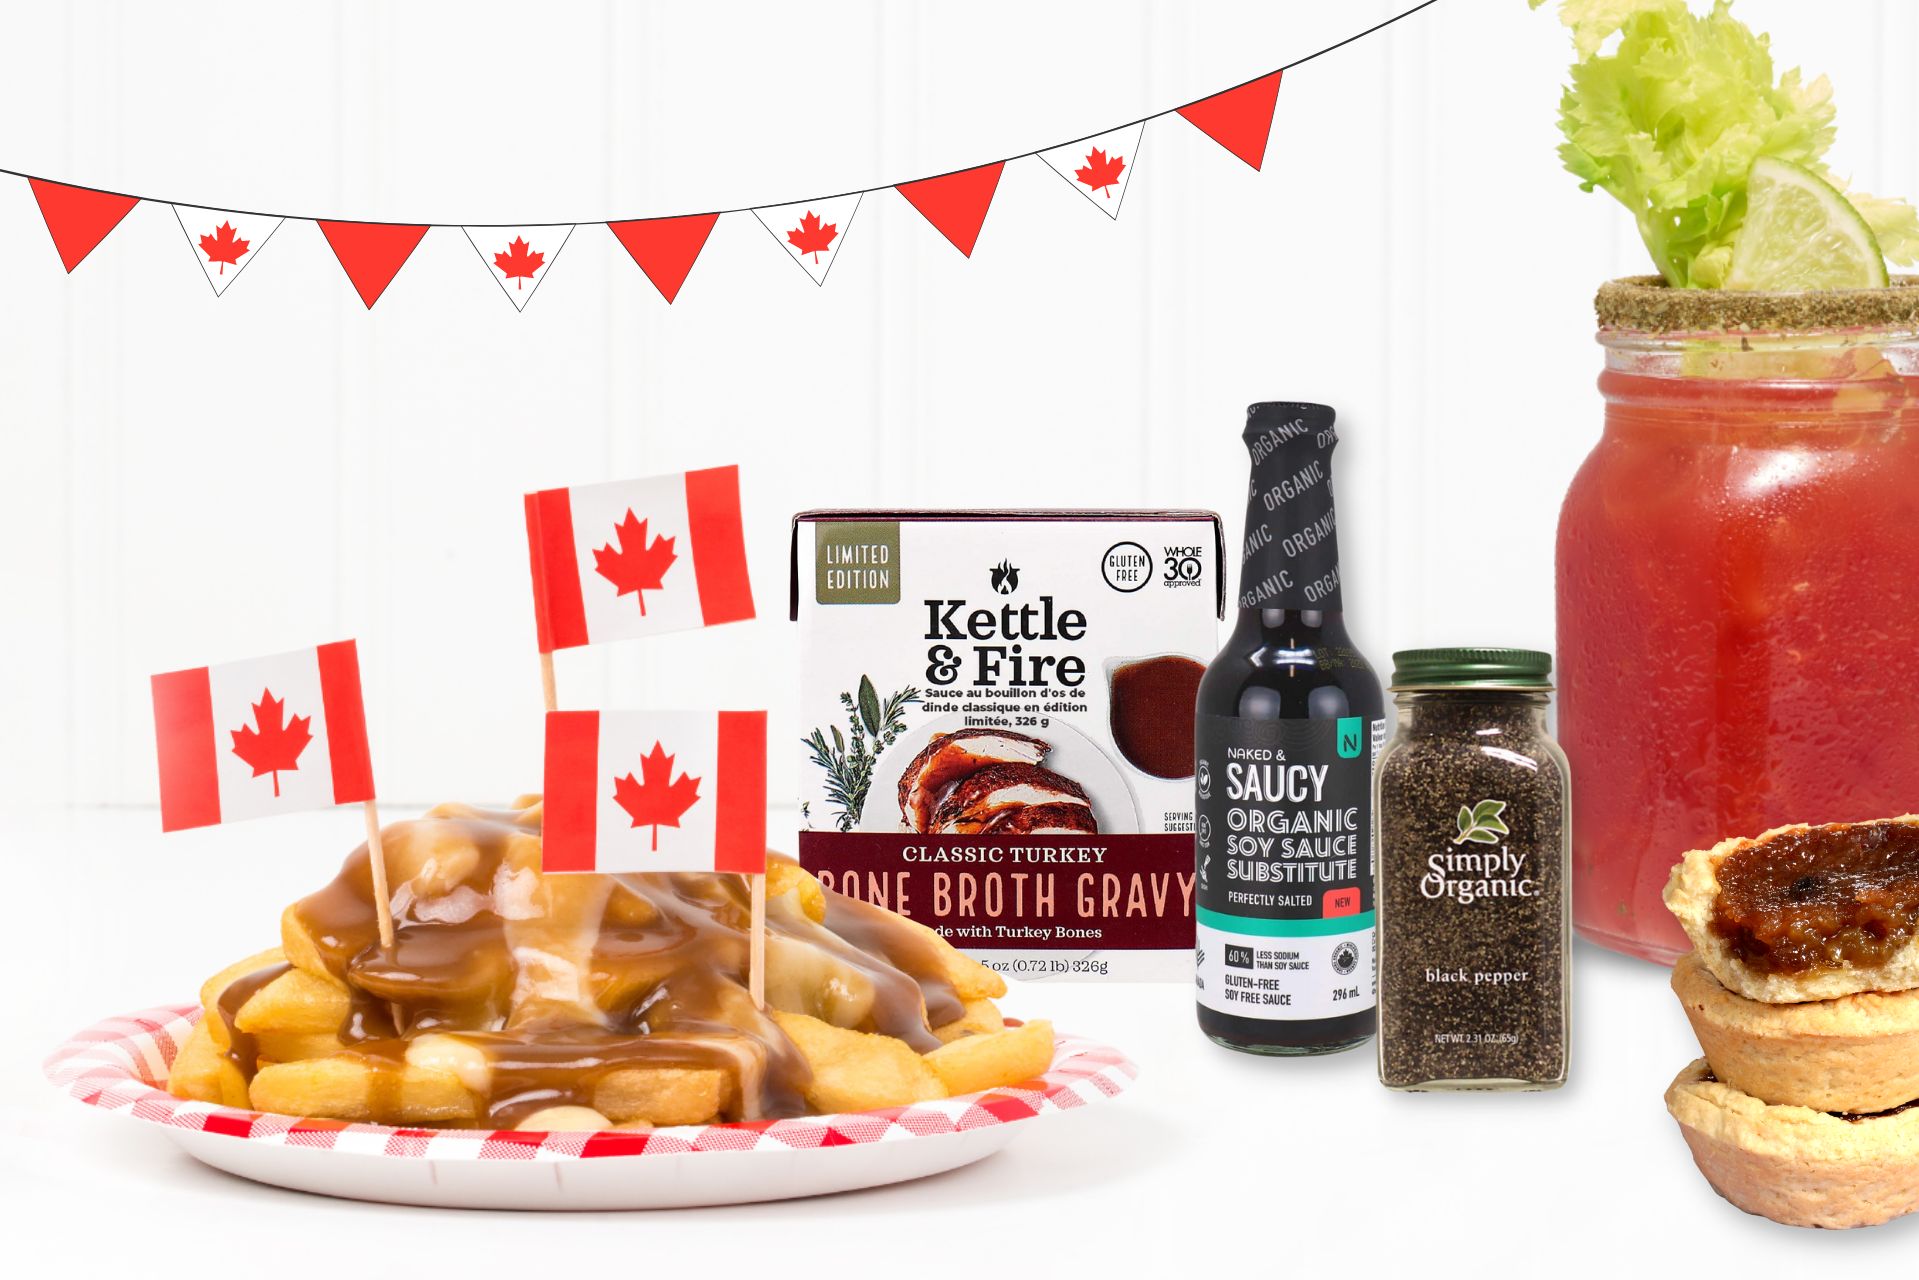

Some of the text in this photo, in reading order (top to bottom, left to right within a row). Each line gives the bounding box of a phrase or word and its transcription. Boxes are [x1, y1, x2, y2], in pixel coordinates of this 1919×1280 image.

[1252, 418, 1308, 466] ORGANIC
[1263, 460, 1323, 511] ORGANIC
[827, 544, 889, 565] LIMITED
[1163, 546, 1202, 557] WHOLE
[1109, 555, 1145, 568] GLUTEN
[1163, 557, 1202, 581] 30
[827, 569, 889, 590] EDITION
[1116, 569, 1138, 581] FREE
[1163, 579, 1201, 588] approved
[924, 596, 1087, 641] Kettle
[925, 644, 1086, 687] & Fire
[925, 688, 1086, 698] Sauce au bouillon d'os de
[922, 702, 1088, 714] dinde classique en édition
[964, 716, 1049, 728] limitée, 326 g
[1343, 734, 1357, 752] N
[1227, 747, 1286, 762] NAKED &
[1226, 762, 1329, 803] SAUCY
[1164, 812, 1193, 821] SERVING
[1227, 807, 1358, 834] ORGANIC
[902, 846, 1107, 863] CLASSIC TURKEY
[1227, 834, 1357, 859] SOY SAUCE
[1227, 858, 1357, 883] SUBSTITUTE
[1428, 846, 1526, 881] Simply
[933, 871, 1056, 918] BROTH
[1077, 872, 1196, 918] GRAVY
[1228, 891, 1312, 906] PERFECTLY SALTED
[1334, 897, 1351, 909] NEW
[956, 925, 992, 938] with
[996, 926, 1052, 941] Turkey
[1055, 926, 1102, 938] Bones
[1256, 951, 1300, 960] LESS SODIUM
[992, 962, 1009, 972] oz
[1013, 959, 1047, 973] (0.72
[1051, 959, 1070, 973] lb)
[1072, 960, 1108, 974] 326g
[1256, 961, 1309, 970] THAN SOY SAUCE
[1225, 974, 1280, 991] GLUTEN-FREE
[1426, 968, 1529, 985] black pepper
[1225, 989, 1292, 1006] SOY FREE SAUCE
[1332, 986, 1360, 1002] 296 mL
[1434, 1033, 1450, 1043] NET
